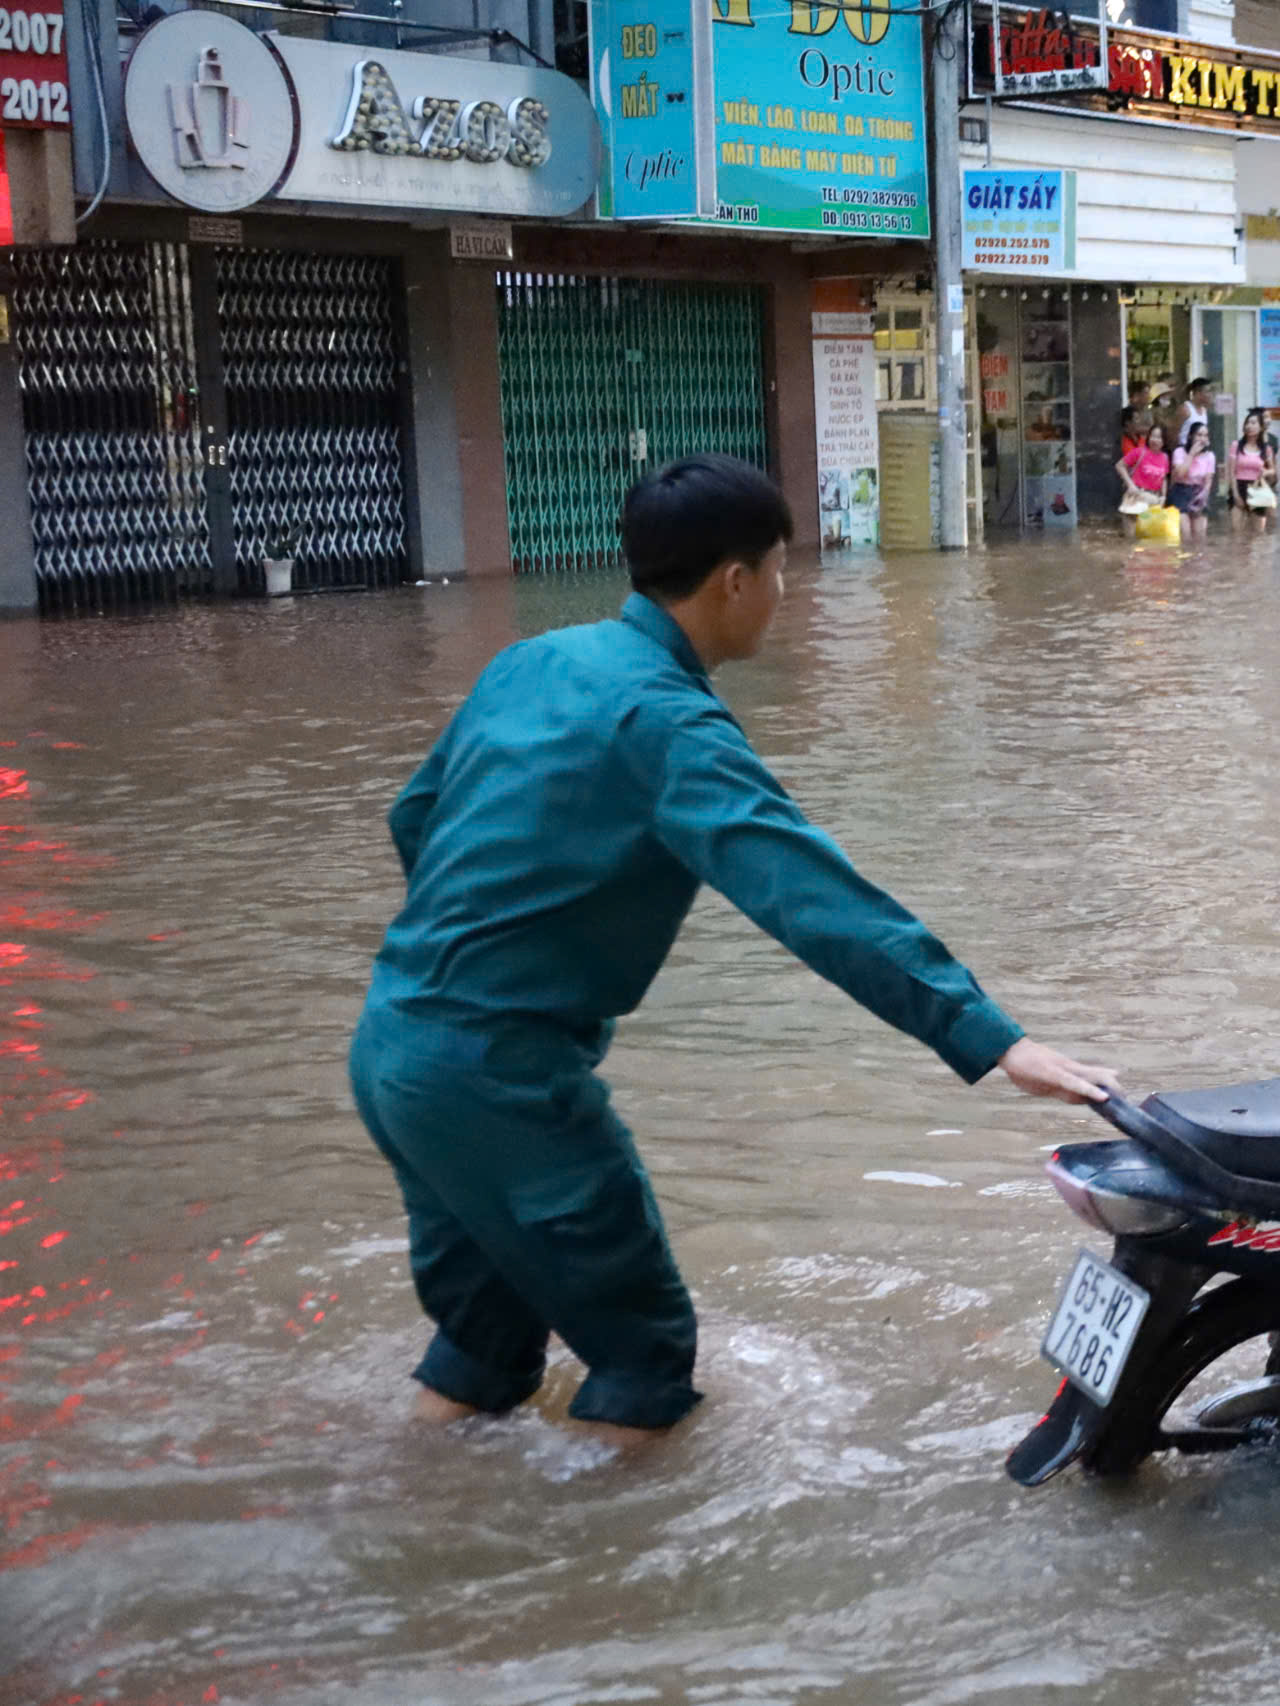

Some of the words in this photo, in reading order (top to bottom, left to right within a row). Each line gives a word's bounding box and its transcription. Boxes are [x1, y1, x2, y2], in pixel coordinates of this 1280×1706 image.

[0, 8, 63, 54] 2007
[621, 71, 658, 118] MẮT
[800, 49, 894, 101] Optic
[1169, 56, 1246, 112] KIM
[1, 78, 70, 122] 2012
[843, 189, 870, 204] 0292
[872, 192, 917, 207] 3829296
[968, 178, 1015, 217] GIẶT
[1017, 174, 1057, 210] SẤY
[843, 212, 868, 227] 0913
[870, 213, 882, 228] 13
[885, 214, 897, 229] 56
[901, 215, 912, 230] 13
[1074, 1263, 1134, 1340] 65-H2
[1054, 1312, 1113, 1388] 7686
